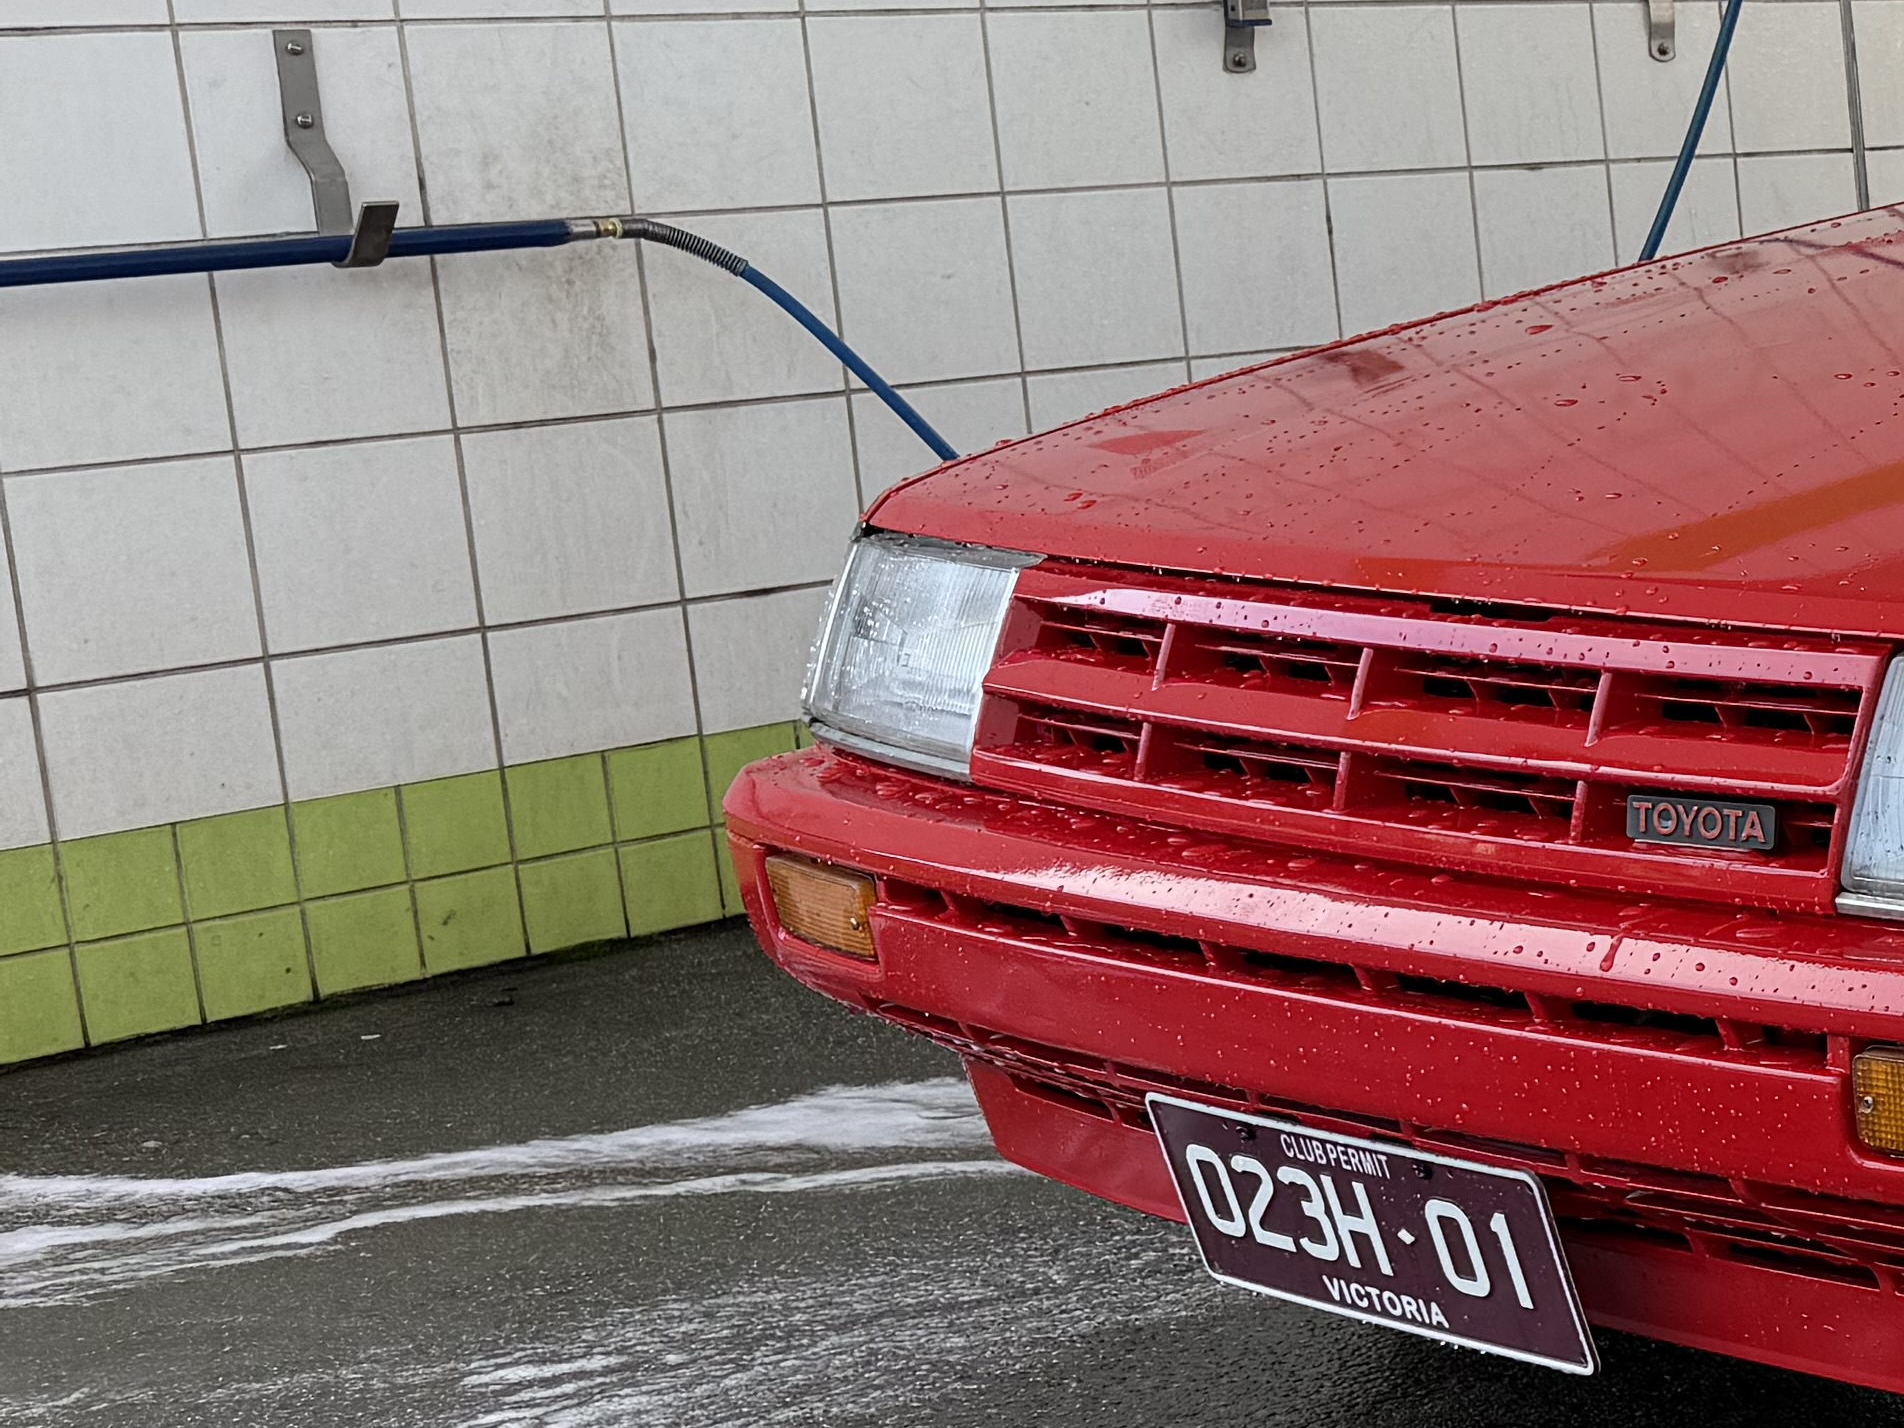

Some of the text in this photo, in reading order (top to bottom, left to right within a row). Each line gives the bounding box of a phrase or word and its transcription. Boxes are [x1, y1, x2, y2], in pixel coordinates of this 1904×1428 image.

[1632, 801, 1766, 844] TOYOTA
[1280, 1133, 1391, 1180] CLUB PERMIT
[1321, 1275, 1450, 1330] VICTORIA
